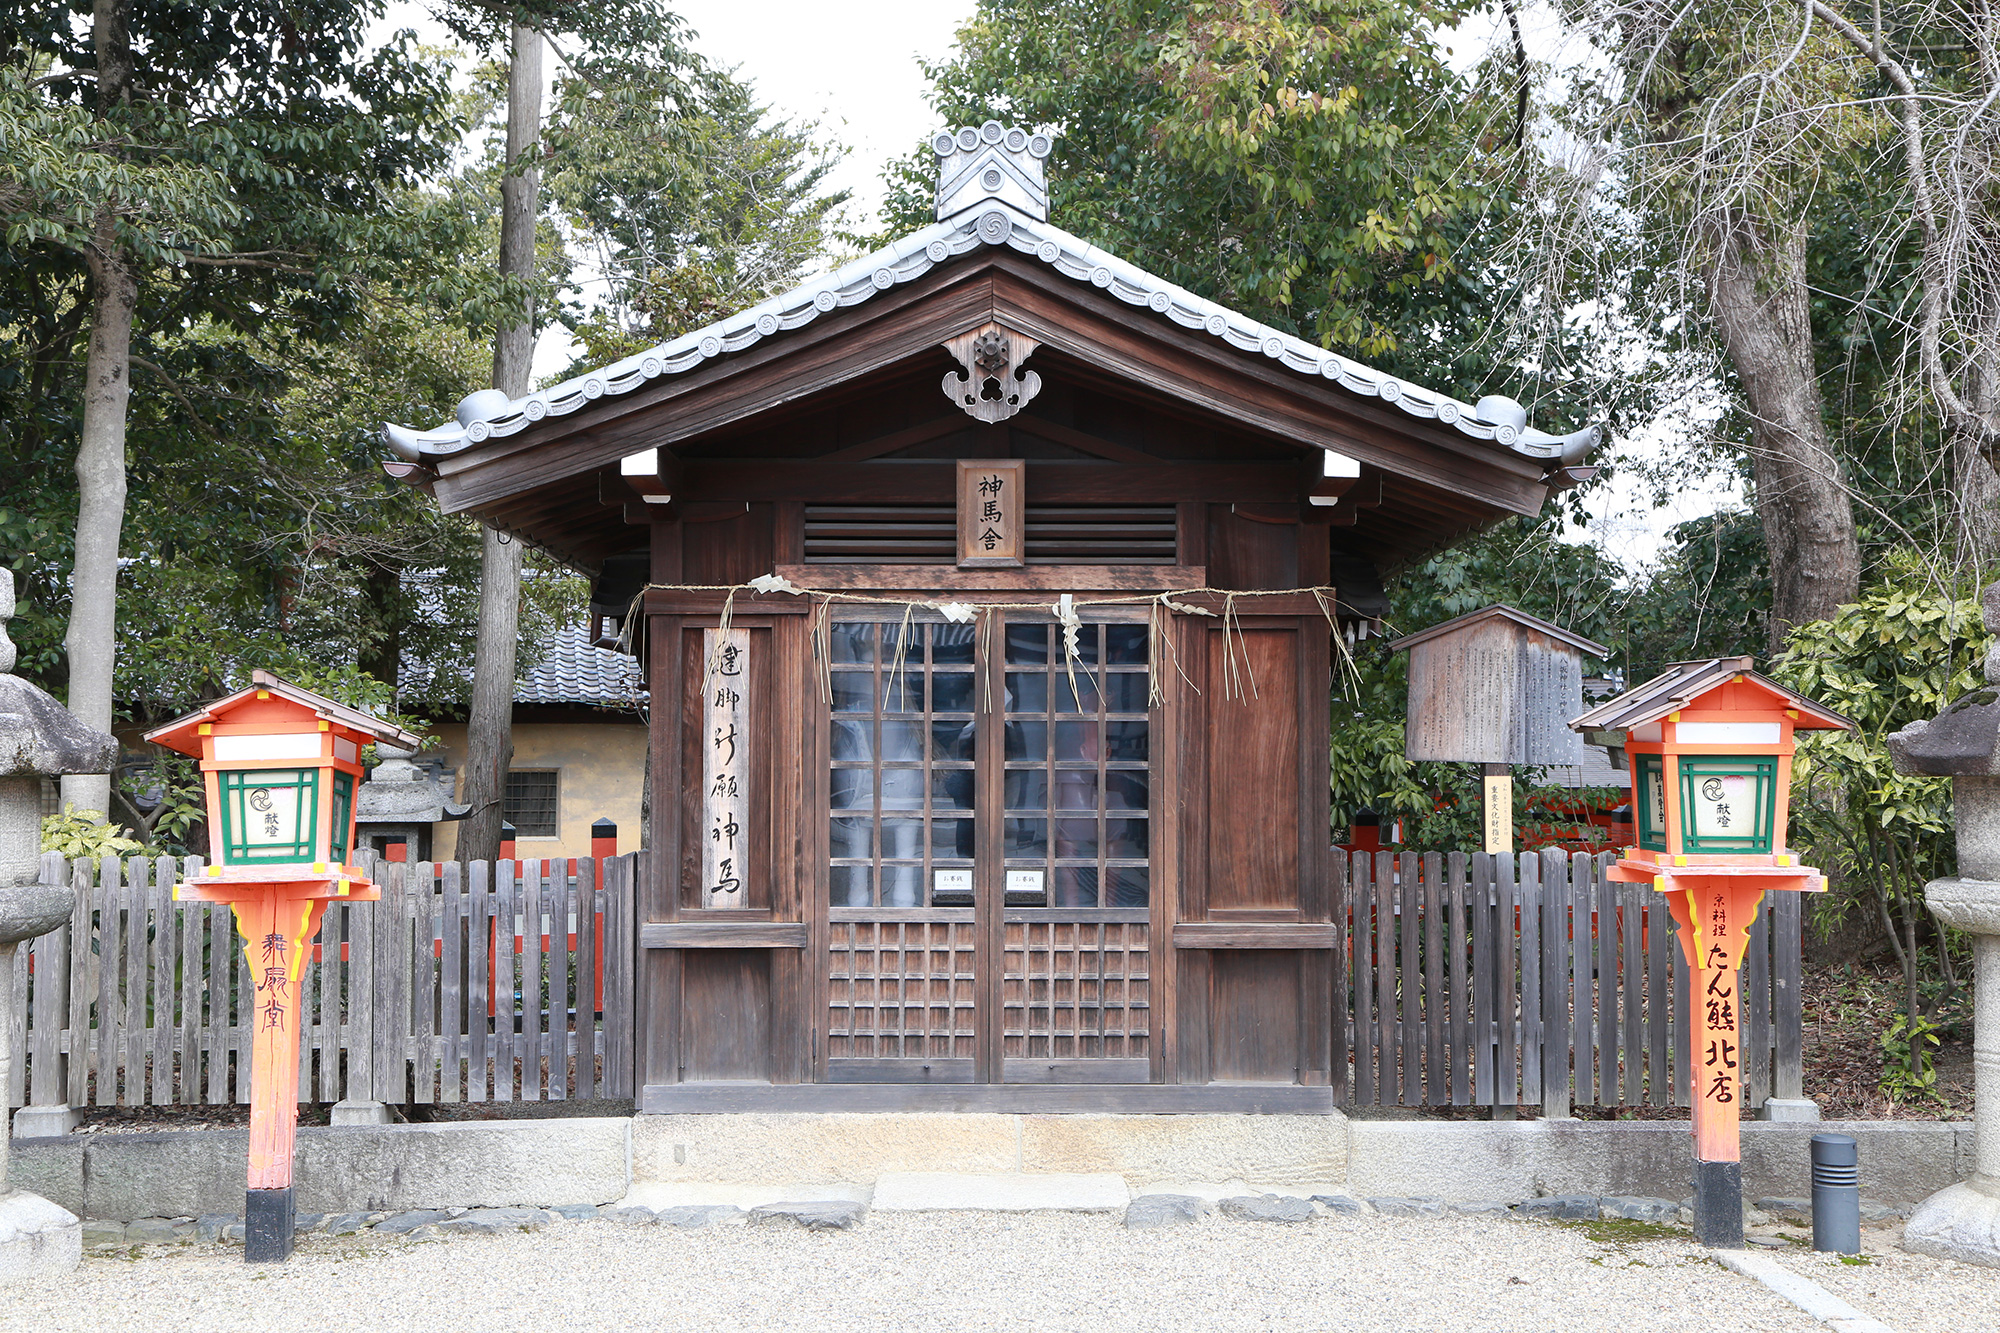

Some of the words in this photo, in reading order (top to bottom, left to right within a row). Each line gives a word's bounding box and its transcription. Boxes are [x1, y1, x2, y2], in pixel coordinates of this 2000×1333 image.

[978, 474, 1004, 551] 神馬舎
[264, 812, 279, 838] 献燈
[1490, 785, 1500, 846] 重要文化財指定
[1716, 803, 1731, 828] 献燈
[1712, 893, 1727, 937] 京料理
[255, 933, 290, 1034] 舞扇堂
[1704, 942, 1737, 1103] たん熊北店
